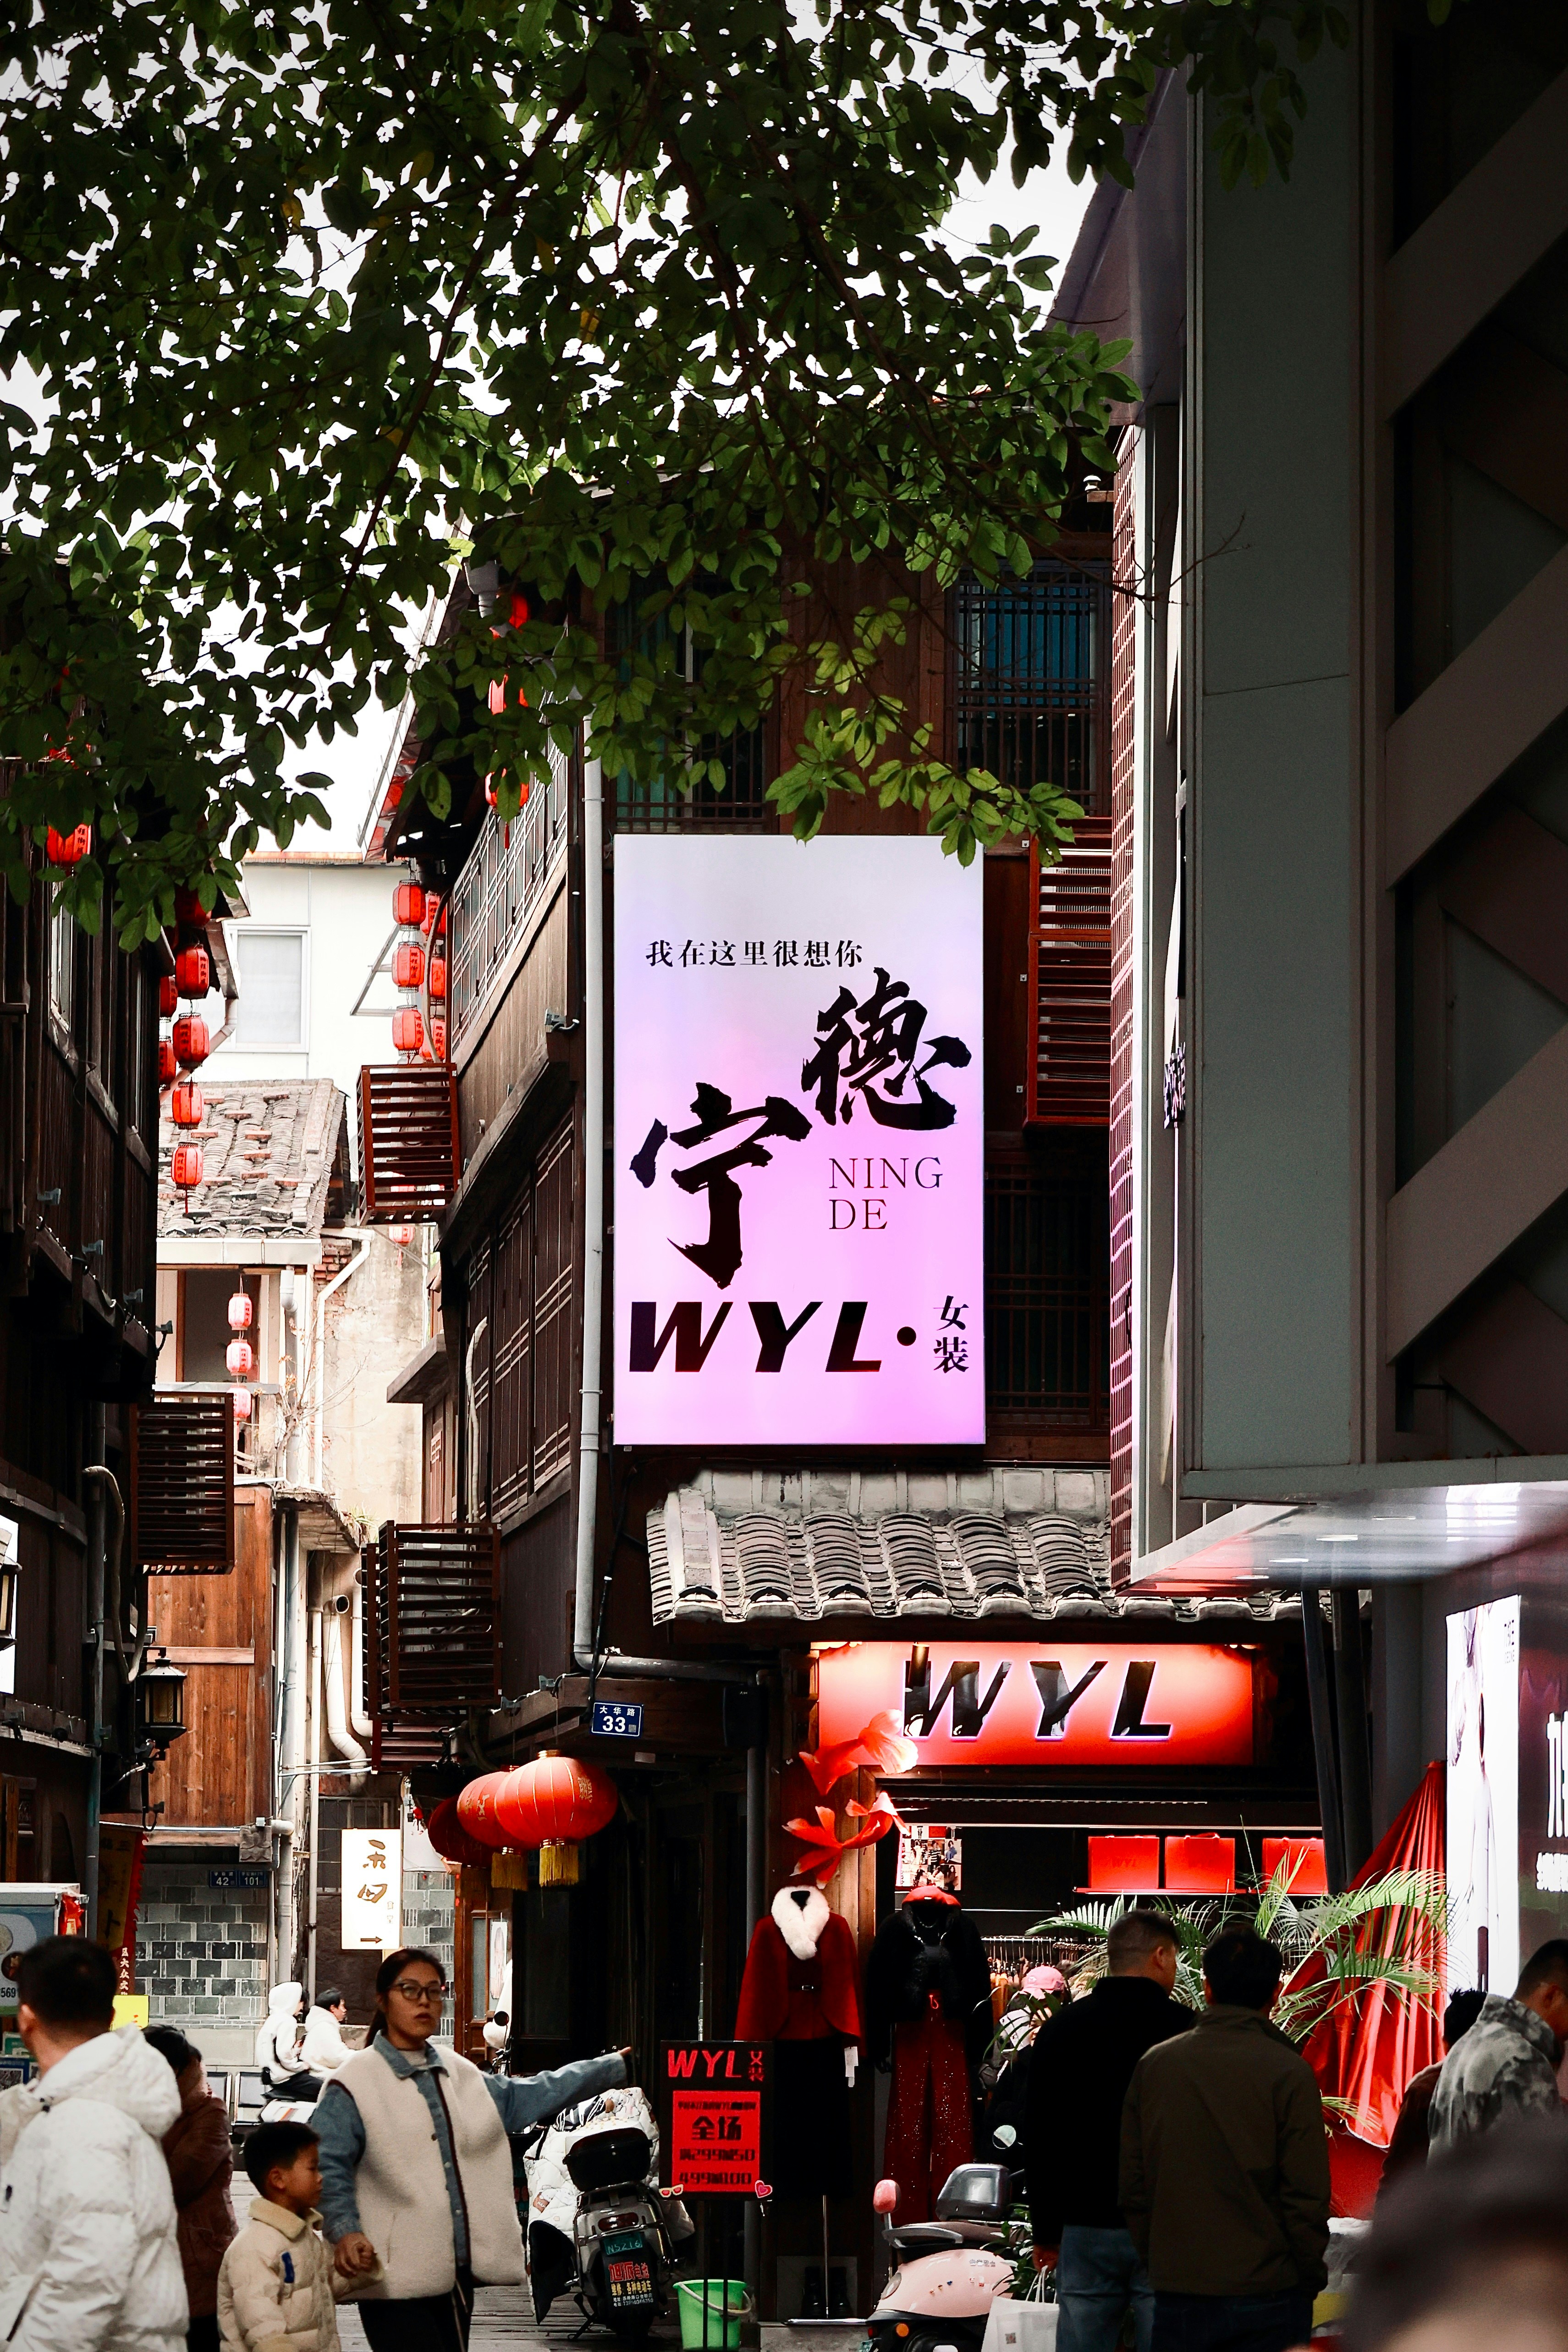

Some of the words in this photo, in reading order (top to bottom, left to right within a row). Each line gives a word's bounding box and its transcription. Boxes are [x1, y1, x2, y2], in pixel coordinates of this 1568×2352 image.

[645, 940, 863, 968] 我在这里很想你
[829, 1157, 943, 1190] NING
[830, 1199, 888, 1230] DE
[933, 1295, 969, 1374] 女装
[599, 1705, 635, 1717] 大华路
[903, 1660, 1172, 1740] WYL
[602, 1715, 626, 1732] 33
[216, 1877, 229, 1885] 42
[245, 1877, 259, 1885] 101
[668, 2049, 742, 2077] WYL
[691, 2115, 742, 2140] 全场
[608, 2261, 649, 2283] 旭派电池
